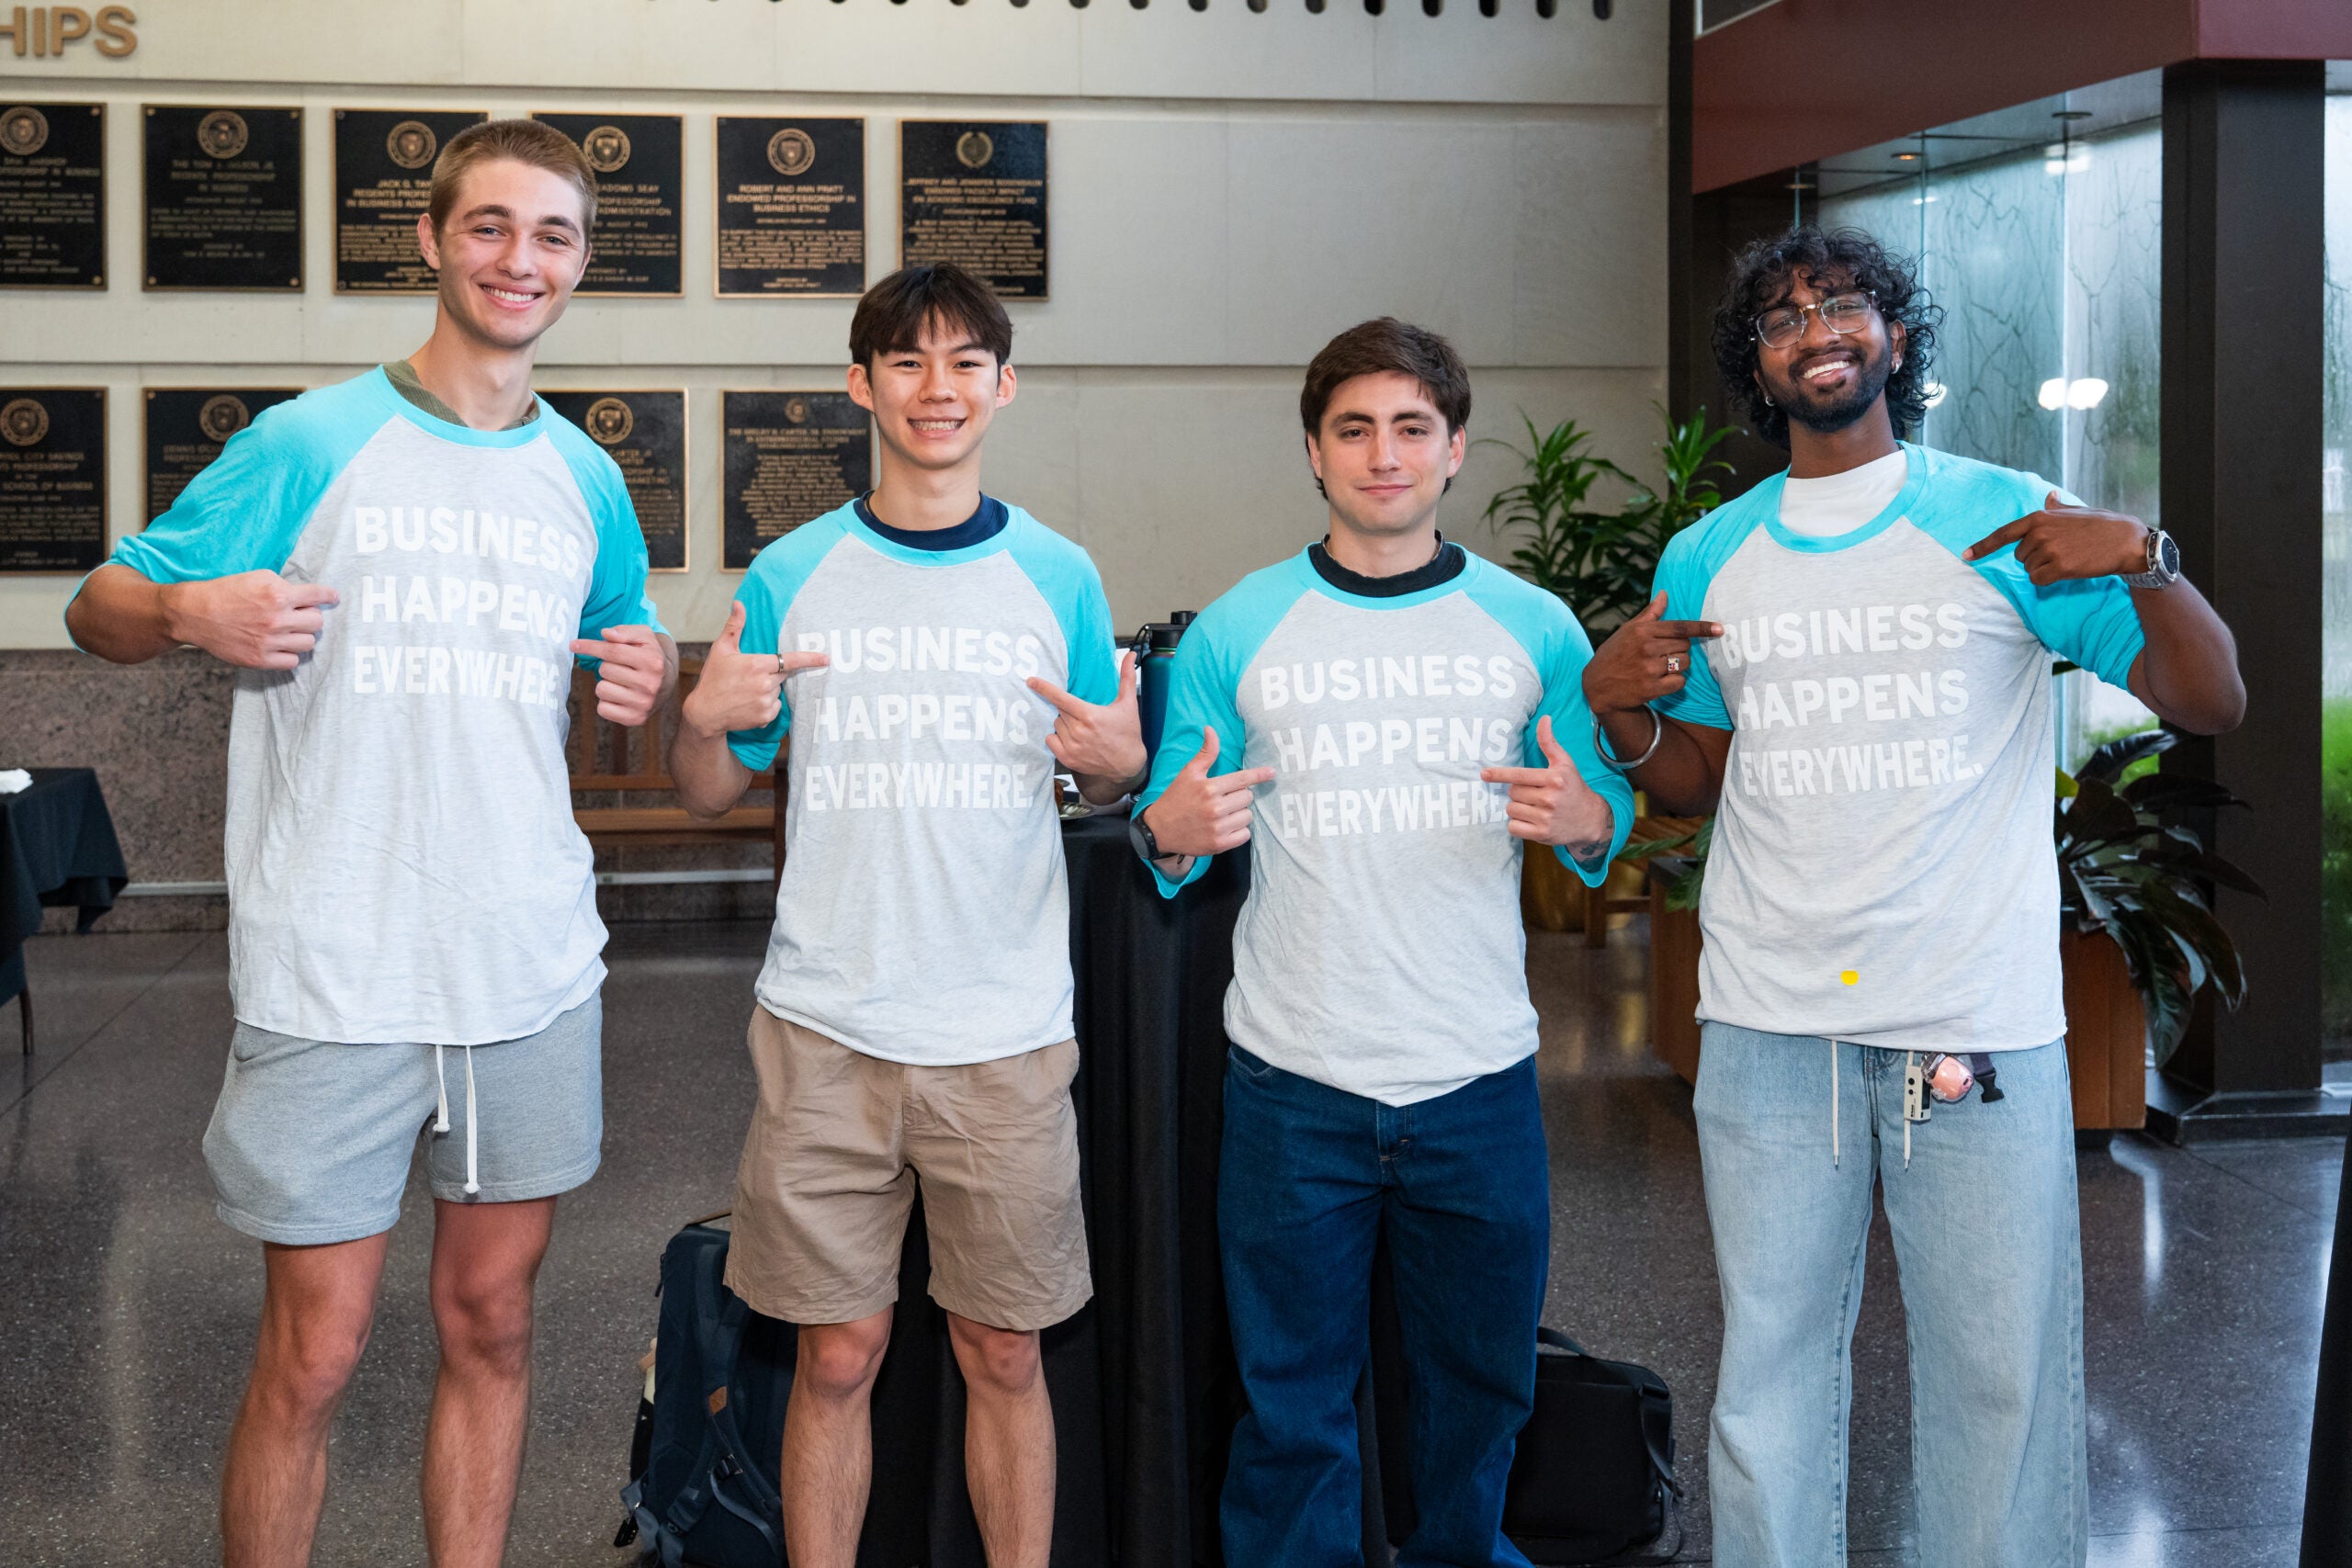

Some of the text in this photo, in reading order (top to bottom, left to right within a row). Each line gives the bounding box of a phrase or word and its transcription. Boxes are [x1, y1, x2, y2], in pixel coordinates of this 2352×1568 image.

[355, 506, 580, 579] BUSINESS
[362, 575, 570, 643] HAPPENS
[1722, 603, 1969, 669] BUSINESS
[797, 626, 1041, 680] BUSINESS
[1261, 655, 1516, 711] BUSINESS
[812, 694, 1032, 745] HAPPENS
[1737, 670, 1969, 730] HAPPENS
[1272, 717, 1513, 773] HAPPENS
[1738, 735, 1984, 797] EVERYWHERE.
